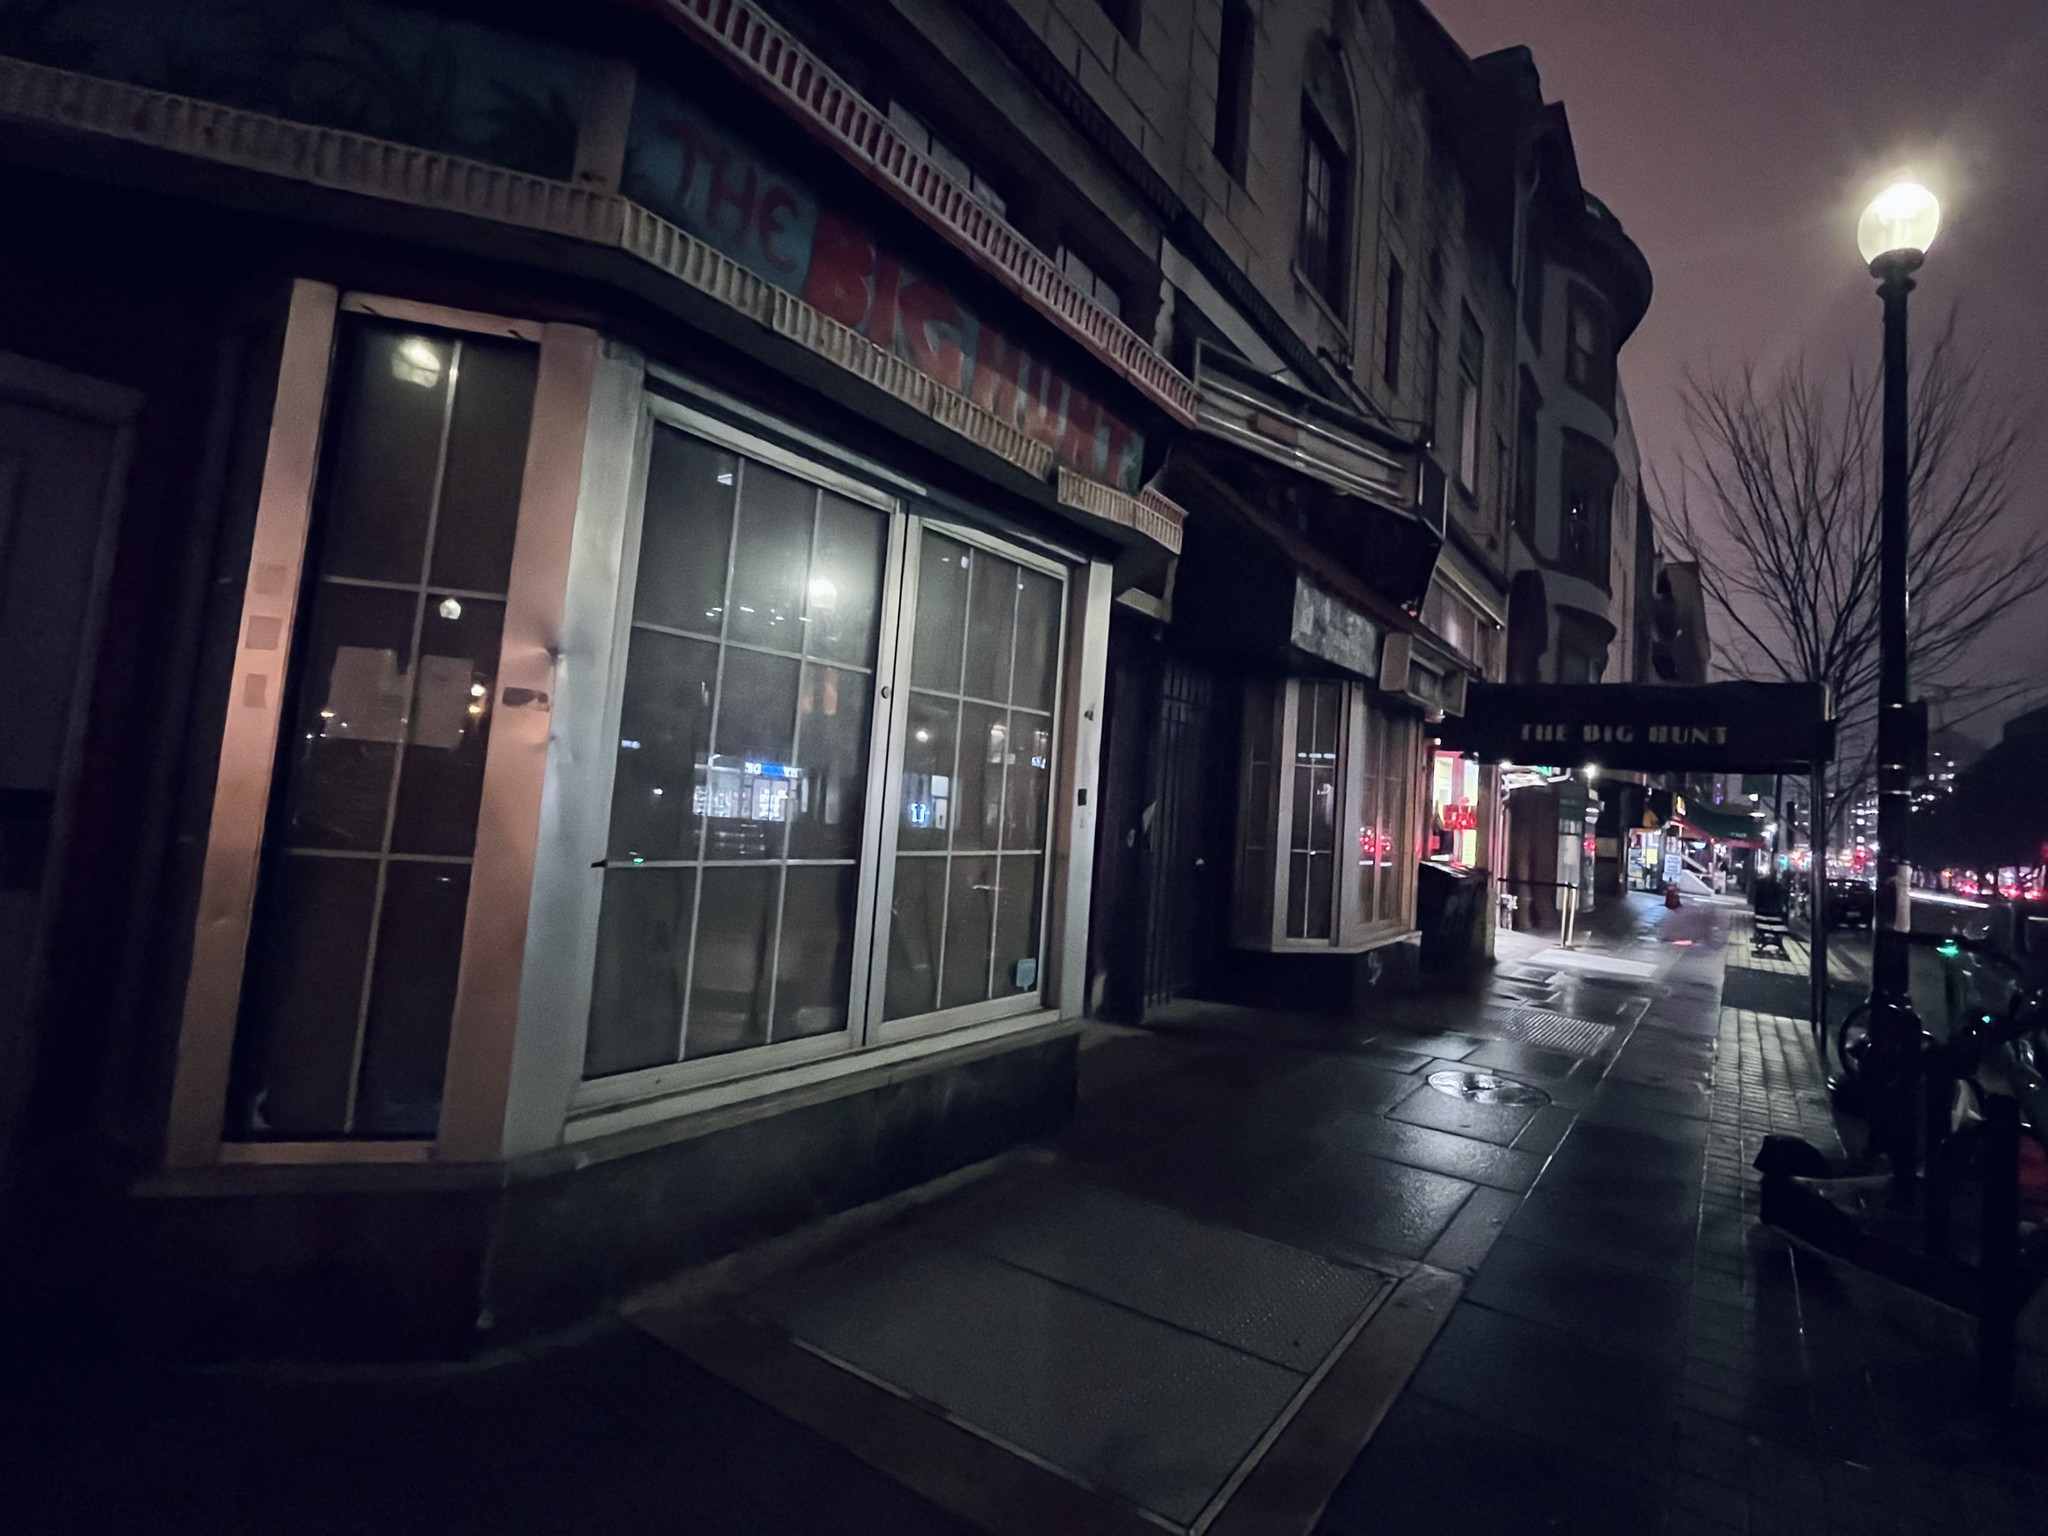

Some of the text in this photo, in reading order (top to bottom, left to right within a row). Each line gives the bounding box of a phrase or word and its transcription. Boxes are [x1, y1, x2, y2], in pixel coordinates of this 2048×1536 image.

[658, 118, 1136, 488] THE BIG HUNT
[1521, 724, 1729, 745] THE BIG HUNT
